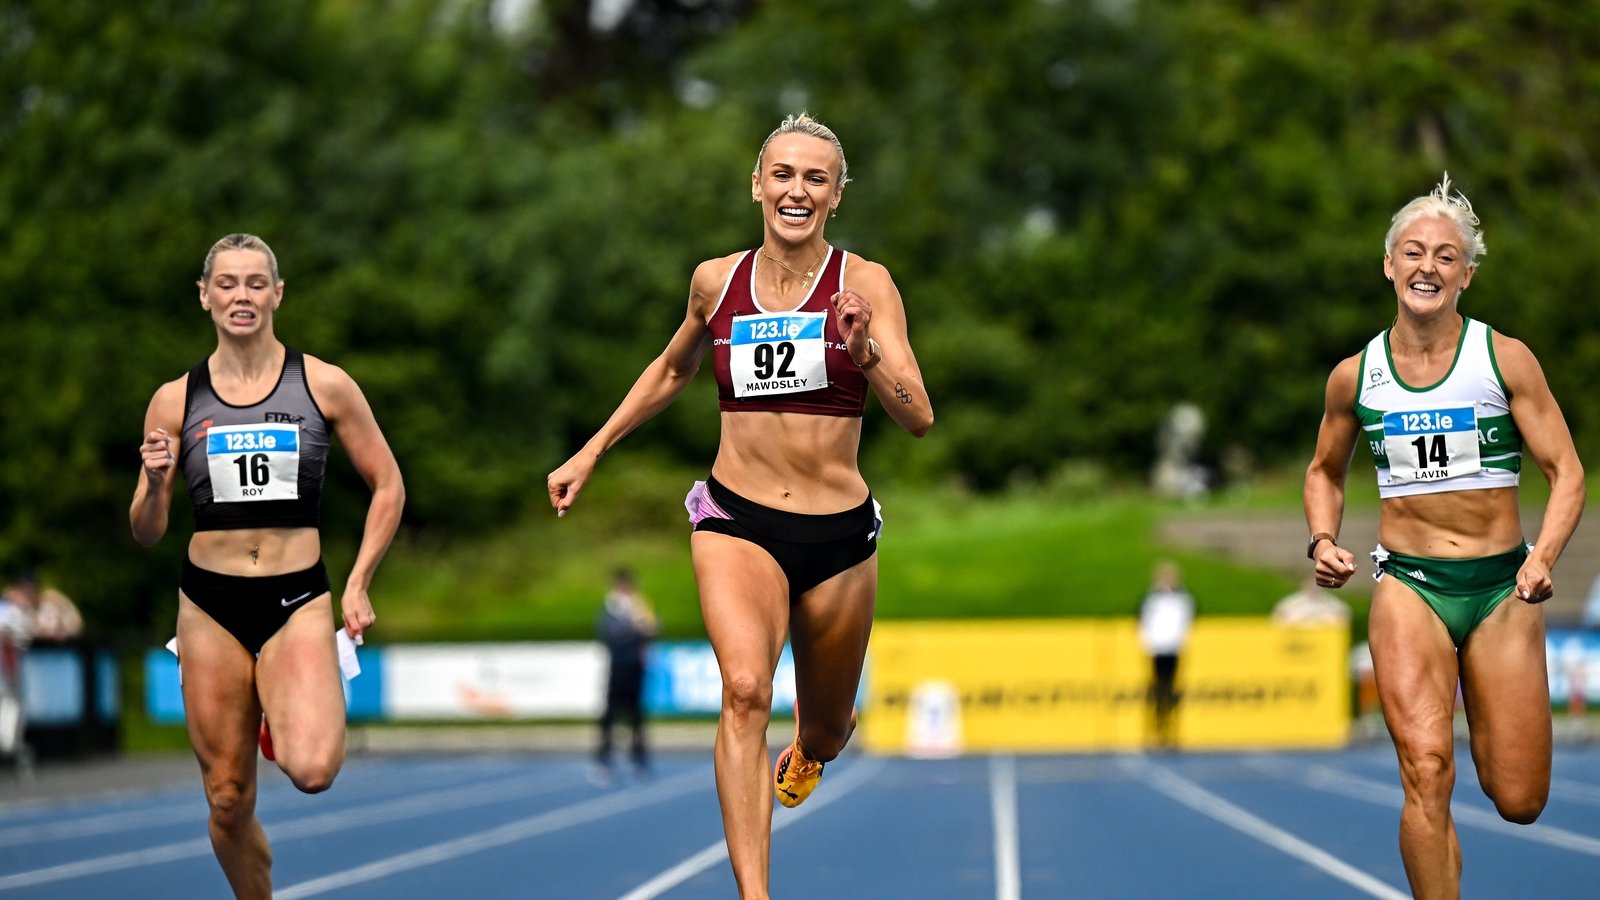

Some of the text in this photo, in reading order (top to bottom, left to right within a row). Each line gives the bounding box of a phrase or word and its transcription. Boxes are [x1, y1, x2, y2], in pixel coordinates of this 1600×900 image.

[750, 320, 800, 340] 123.ie
[835, 343, 847, 351] AC
[754, 341, 796, 380] 92
[746, 378, 808, 391] MAWDSLEY
[1401, 412, 1453, 432] 123.ie
[225, 432, 277, 450] 123.ie
[1478, 426, 1499, 445] AC
[1411, 434, 1449, 469] 14
[233, 453, 270, 487] 16
[1415, 469, 1449, 480] LAVIN
[242, 488, 264, 497] ROY
